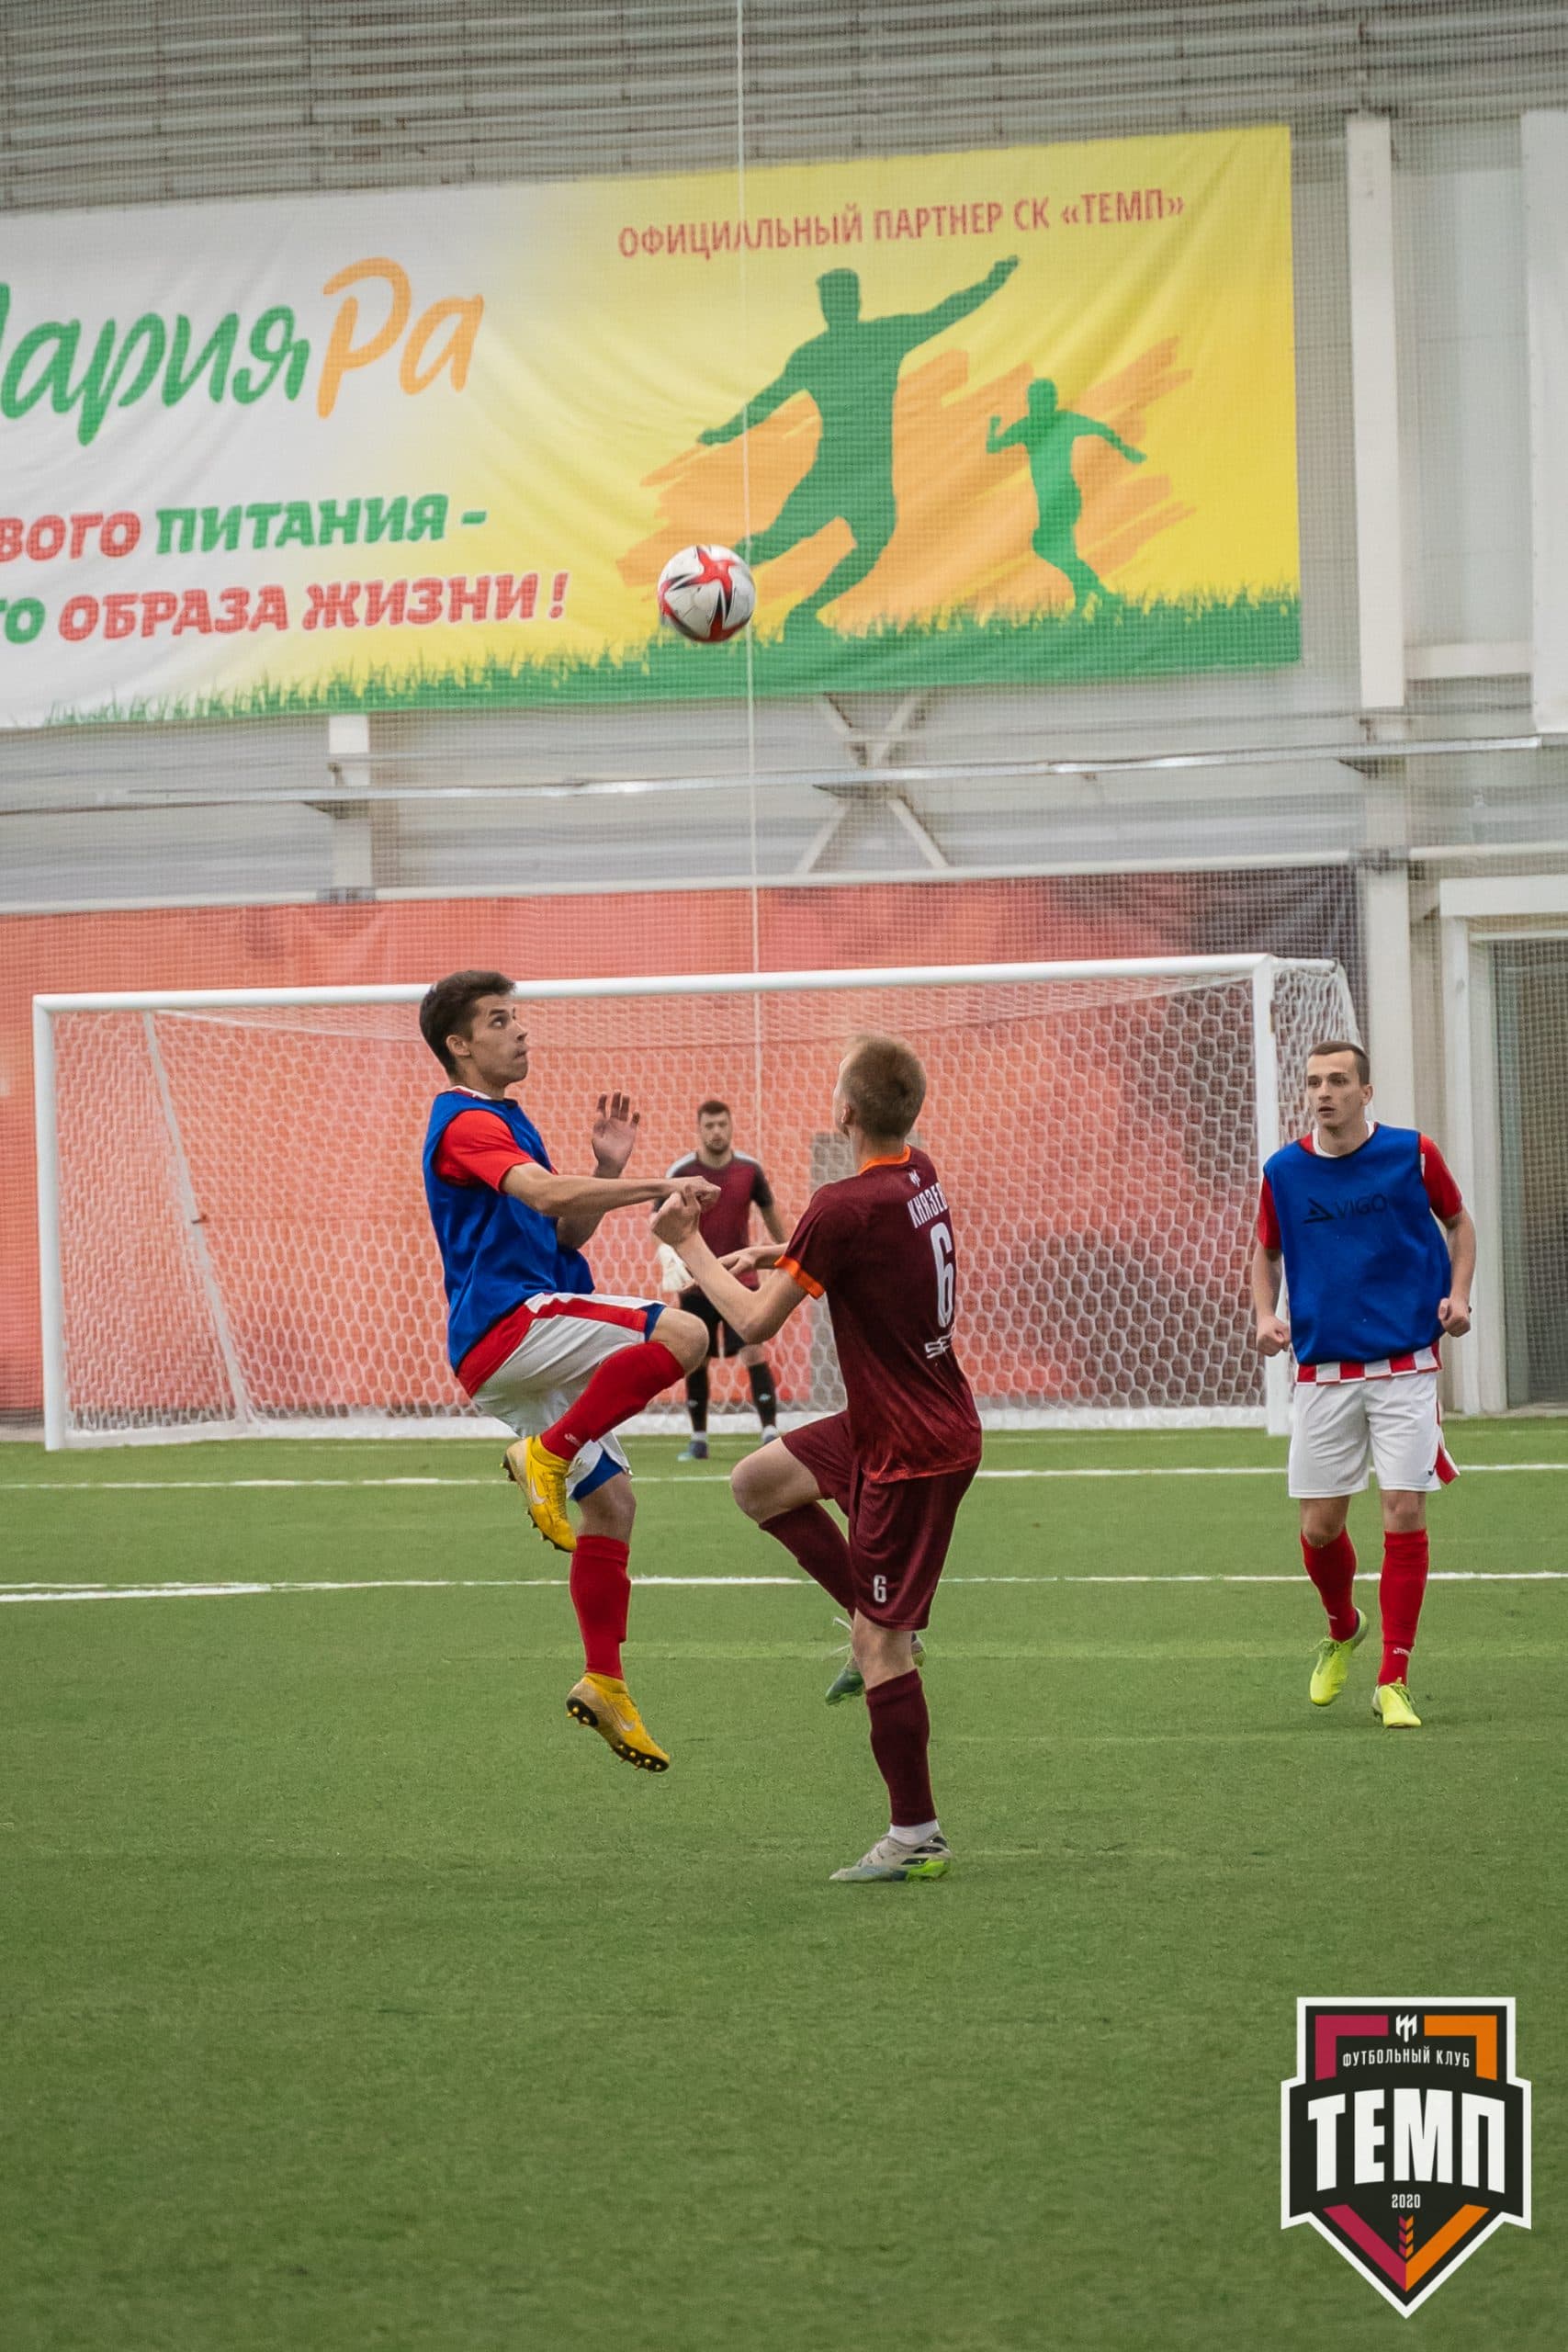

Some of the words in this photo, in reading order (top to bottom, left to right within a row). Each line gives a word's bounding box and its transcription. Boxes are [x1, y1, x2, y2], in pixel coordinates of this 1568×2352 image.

[618, 202, 863, 261] ОФИЦИАЛЬНЫЙ
[874, 201, 1003, 241] ПАРТНЕР
[1013, 196, 1050, 231] СК
[1061, 187, 1185, 225] «ТЕМП»
[155, 493, 449, 555] ПИТАНИЯ
[0, 597, 46, 644] О
[58, 585, 289, 642] ОБРАЗА
[1334, 1193, 1388, 1220] VIGO
[930, 1222, 954, 1328] 6
[873, 1574, 887, 1603] 6
